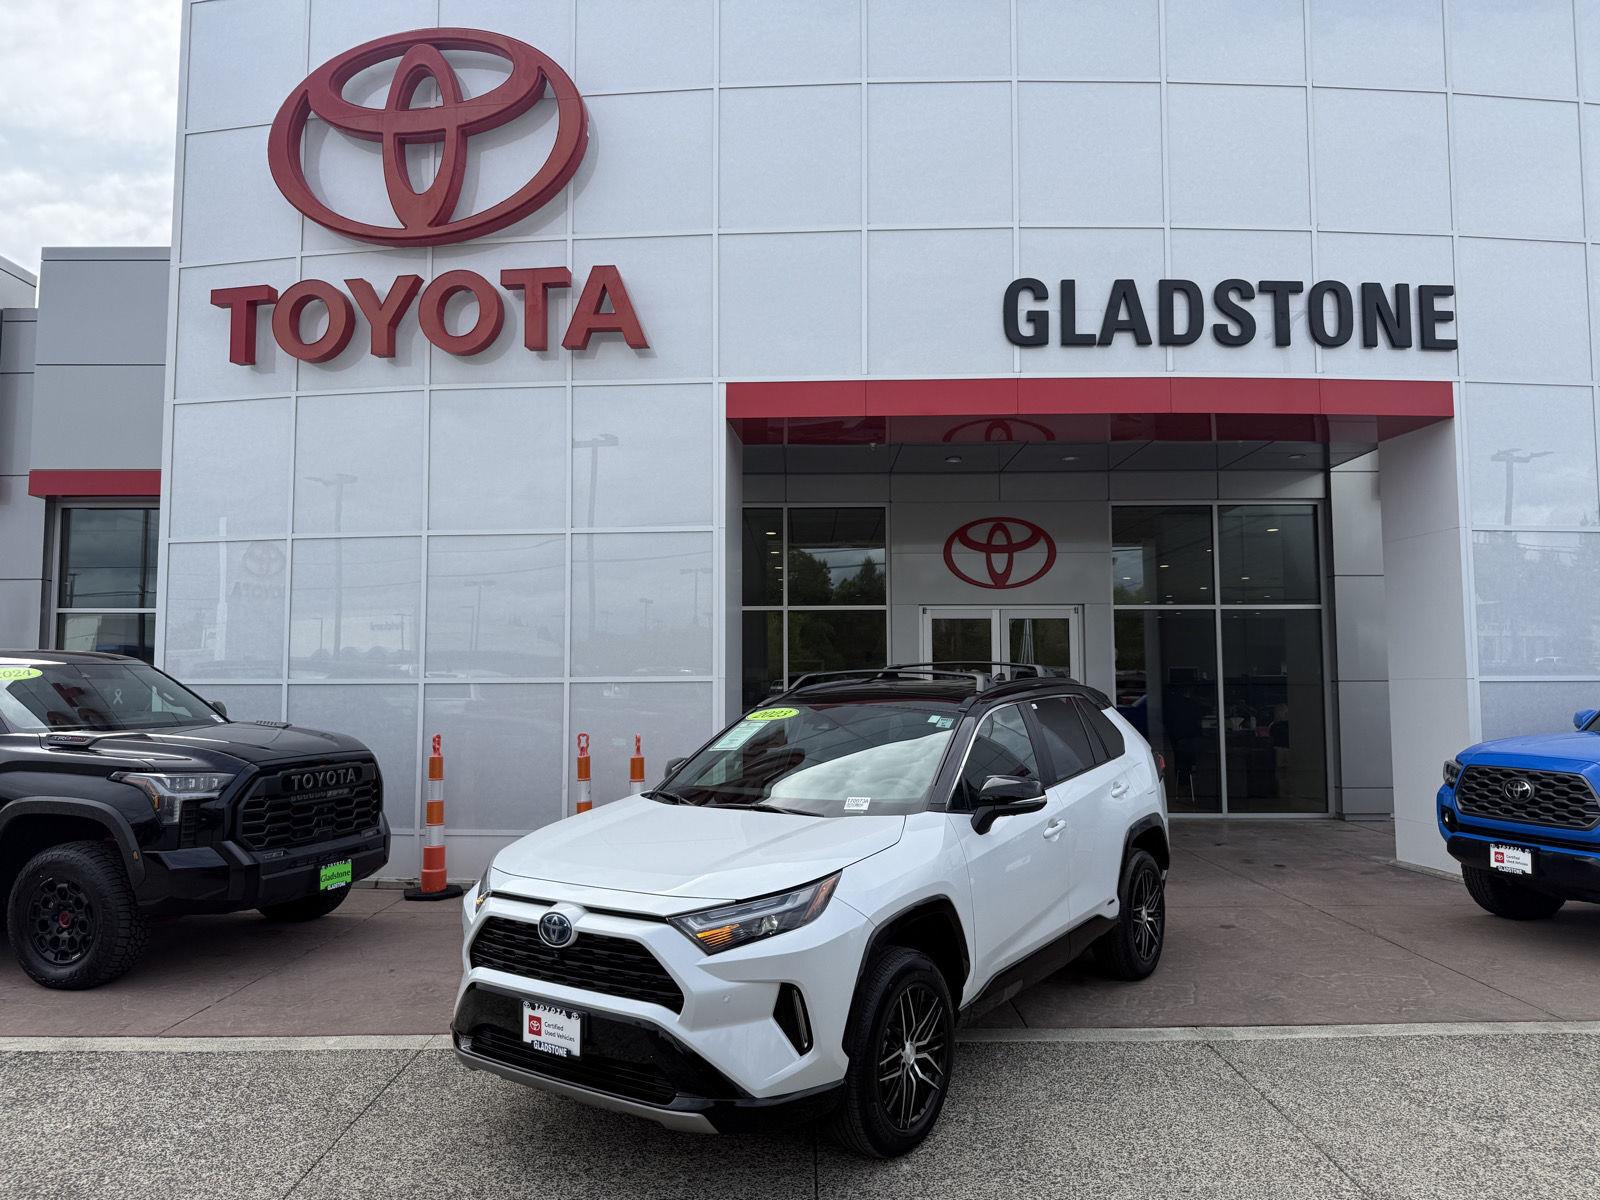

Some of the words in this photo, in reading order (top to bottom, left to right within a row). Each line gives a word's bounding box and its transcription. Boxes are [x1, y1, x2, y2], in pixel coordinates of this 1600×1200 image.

[210, 265, 650, 366] TOYOTA
[1003, 277, 1458, 350] GLADSTONE
[0, 669, 31, 679] 024
[291, 767, 357, 791] TOYOTA
[320, 870, 351, 883] Gladstone
[534, 1003, 567, 1018] TOYOTA
[544, 1021, 564, 1031] Certified
[557, 1033, 575, 1042] Vehicles
[533, 1040, 568, 1058] GLADSTONE
